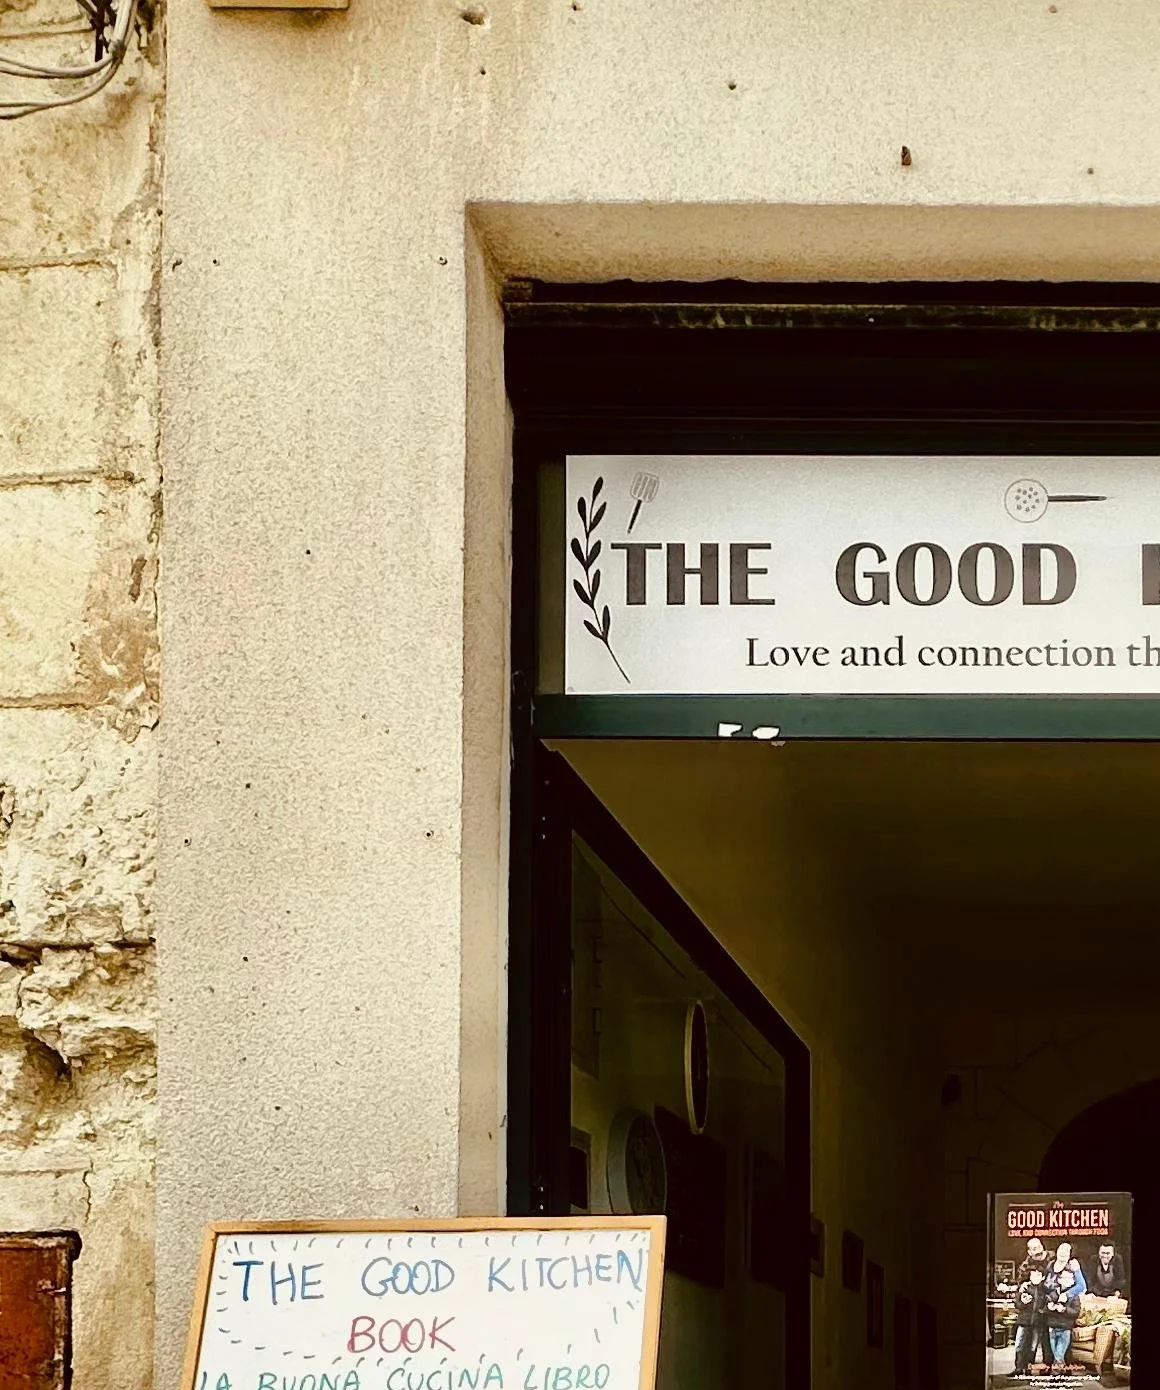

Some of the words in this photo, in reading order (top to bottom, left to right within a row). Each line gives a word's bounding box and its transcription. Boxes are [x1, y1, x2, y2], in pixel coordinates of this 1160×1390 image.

[611, 542, 776, 606] THE
[835, 541, 1076, 607] GOOD
[745, 637, 830, 669] Love
[839, 635, 906, 669] and
[917, 637, 1116, 669] connection
[1008, 1210, 1045, 1229] GOOD
[1049, 1209, 1109, 1228] KITCHEN
[232, 1260, 325, 1305] THE
[361, 1256, 456, 1297] GOOD
[487, 1248, 645, 1294] KITCHEN
[347, 1315, 456, 1354] BOOK
